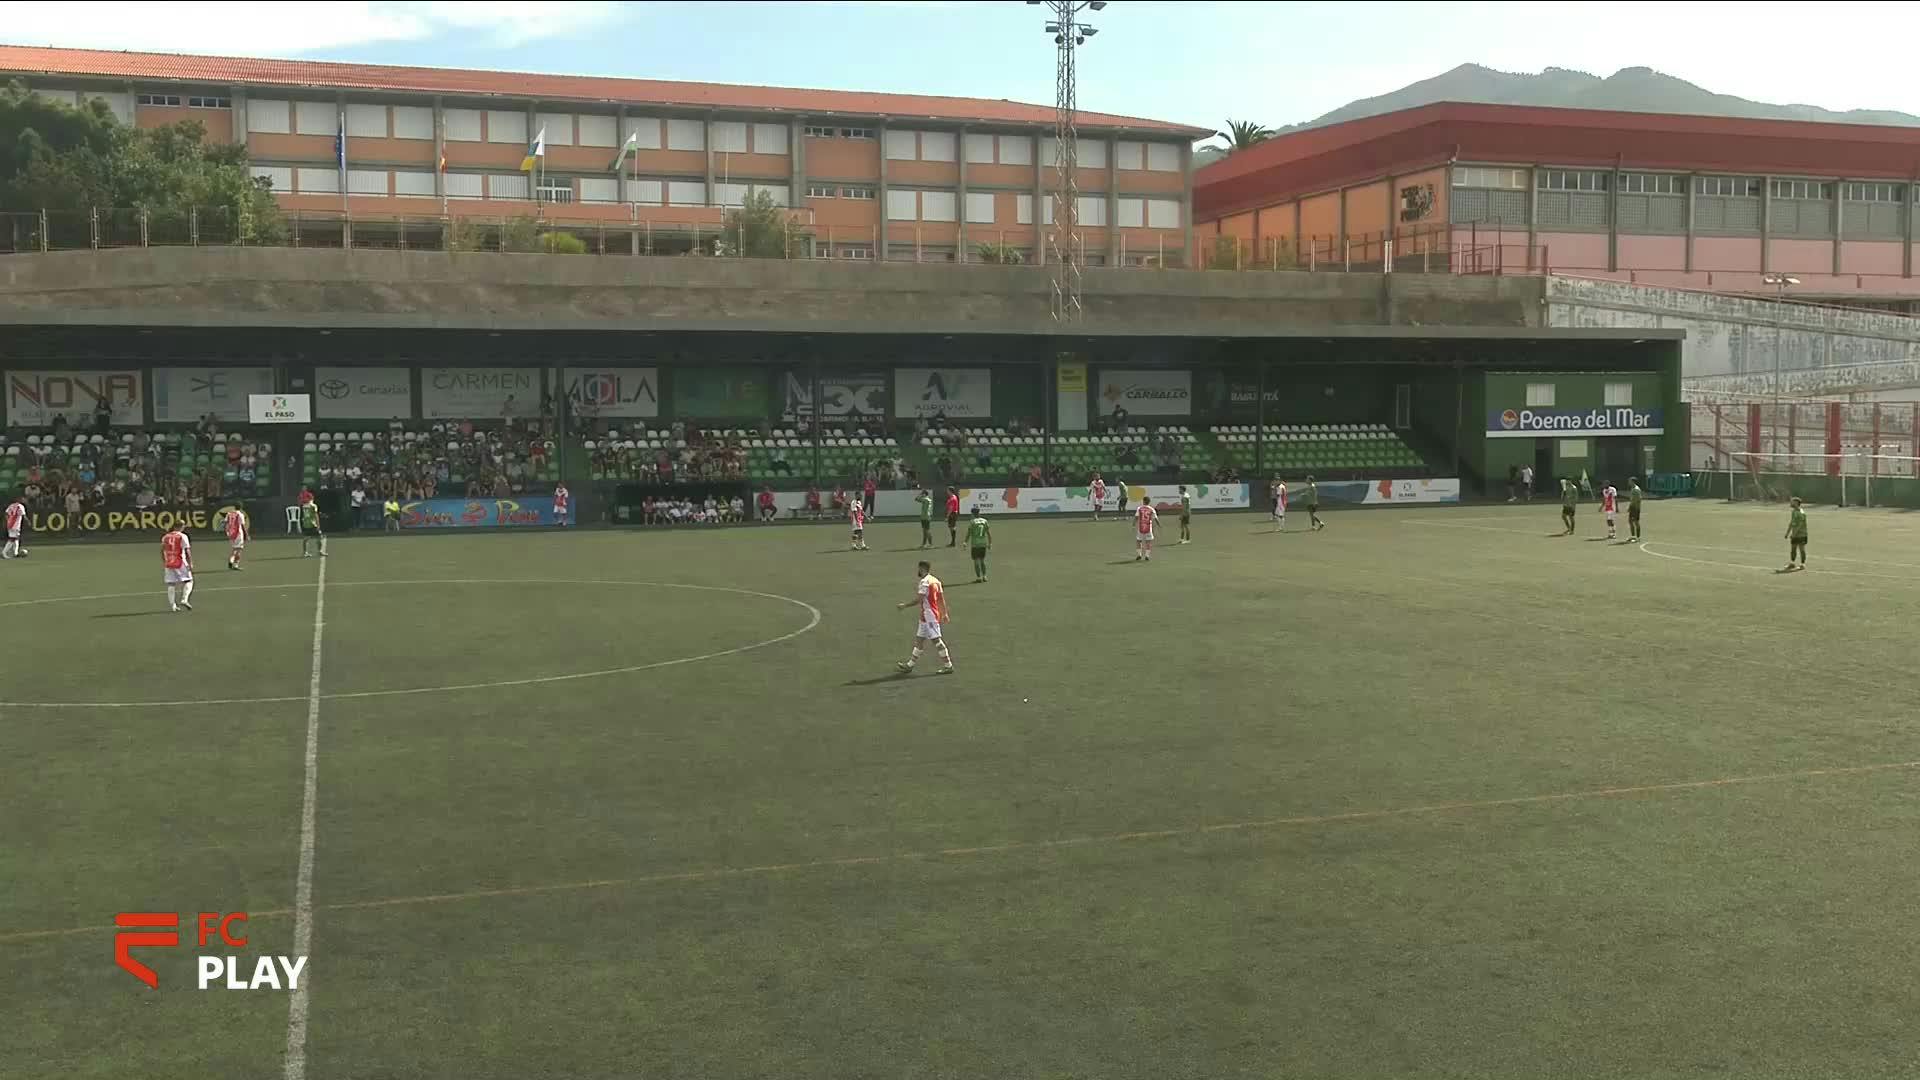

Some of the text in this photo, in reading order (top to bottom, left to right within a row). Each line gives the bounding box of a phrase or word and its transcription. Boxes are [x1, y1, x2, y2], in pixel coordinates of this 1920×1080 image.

[10, 375, 137, 408] NOVA
[432, 373, 530, 390] CARMEN
[1519, 408, 1651, 429] Poema del Mar
[108, 510, 207, 531] PARQUE
